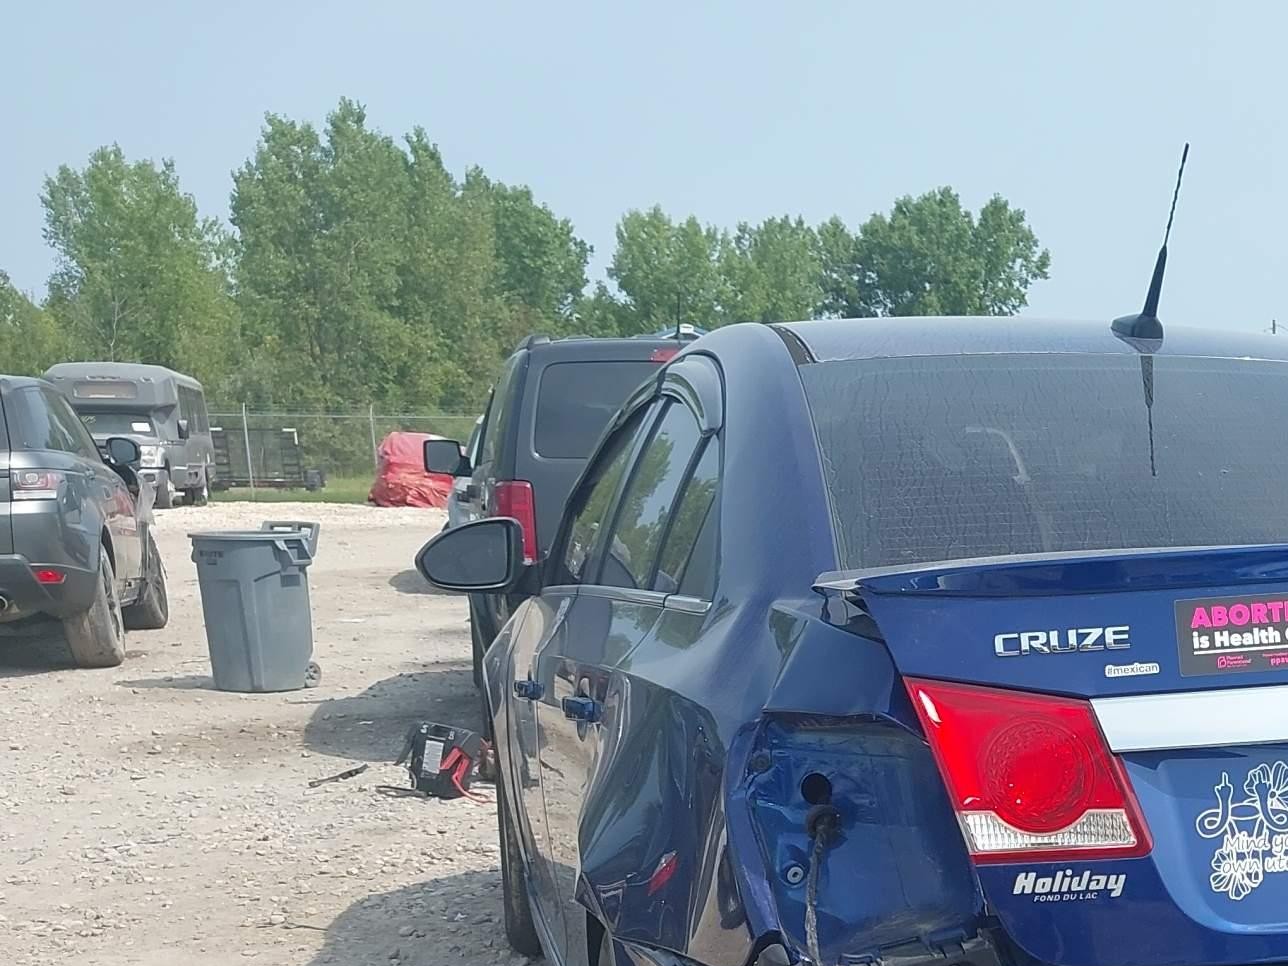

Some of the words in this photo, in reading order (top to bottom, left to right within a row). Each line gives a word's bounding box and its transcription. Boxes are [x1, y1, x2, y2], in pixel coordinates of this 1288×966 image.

[995, 626, 1131, 656] CRUZE
[1193, 631, 1210, 649] is
[1214, 627, 1281, 647] Health
[1107, 664, 1158, 676] #mexican
[1224, 833, 1269, 851] Mind
[1222, 857, 1261, 874] own
[1013, 869, 1126, 897] Holiday
[1034, 894, 1060, 903] FOND
[1063, 893, 1077, 901] DU
[1079, 891, 1098, 900] LAC
